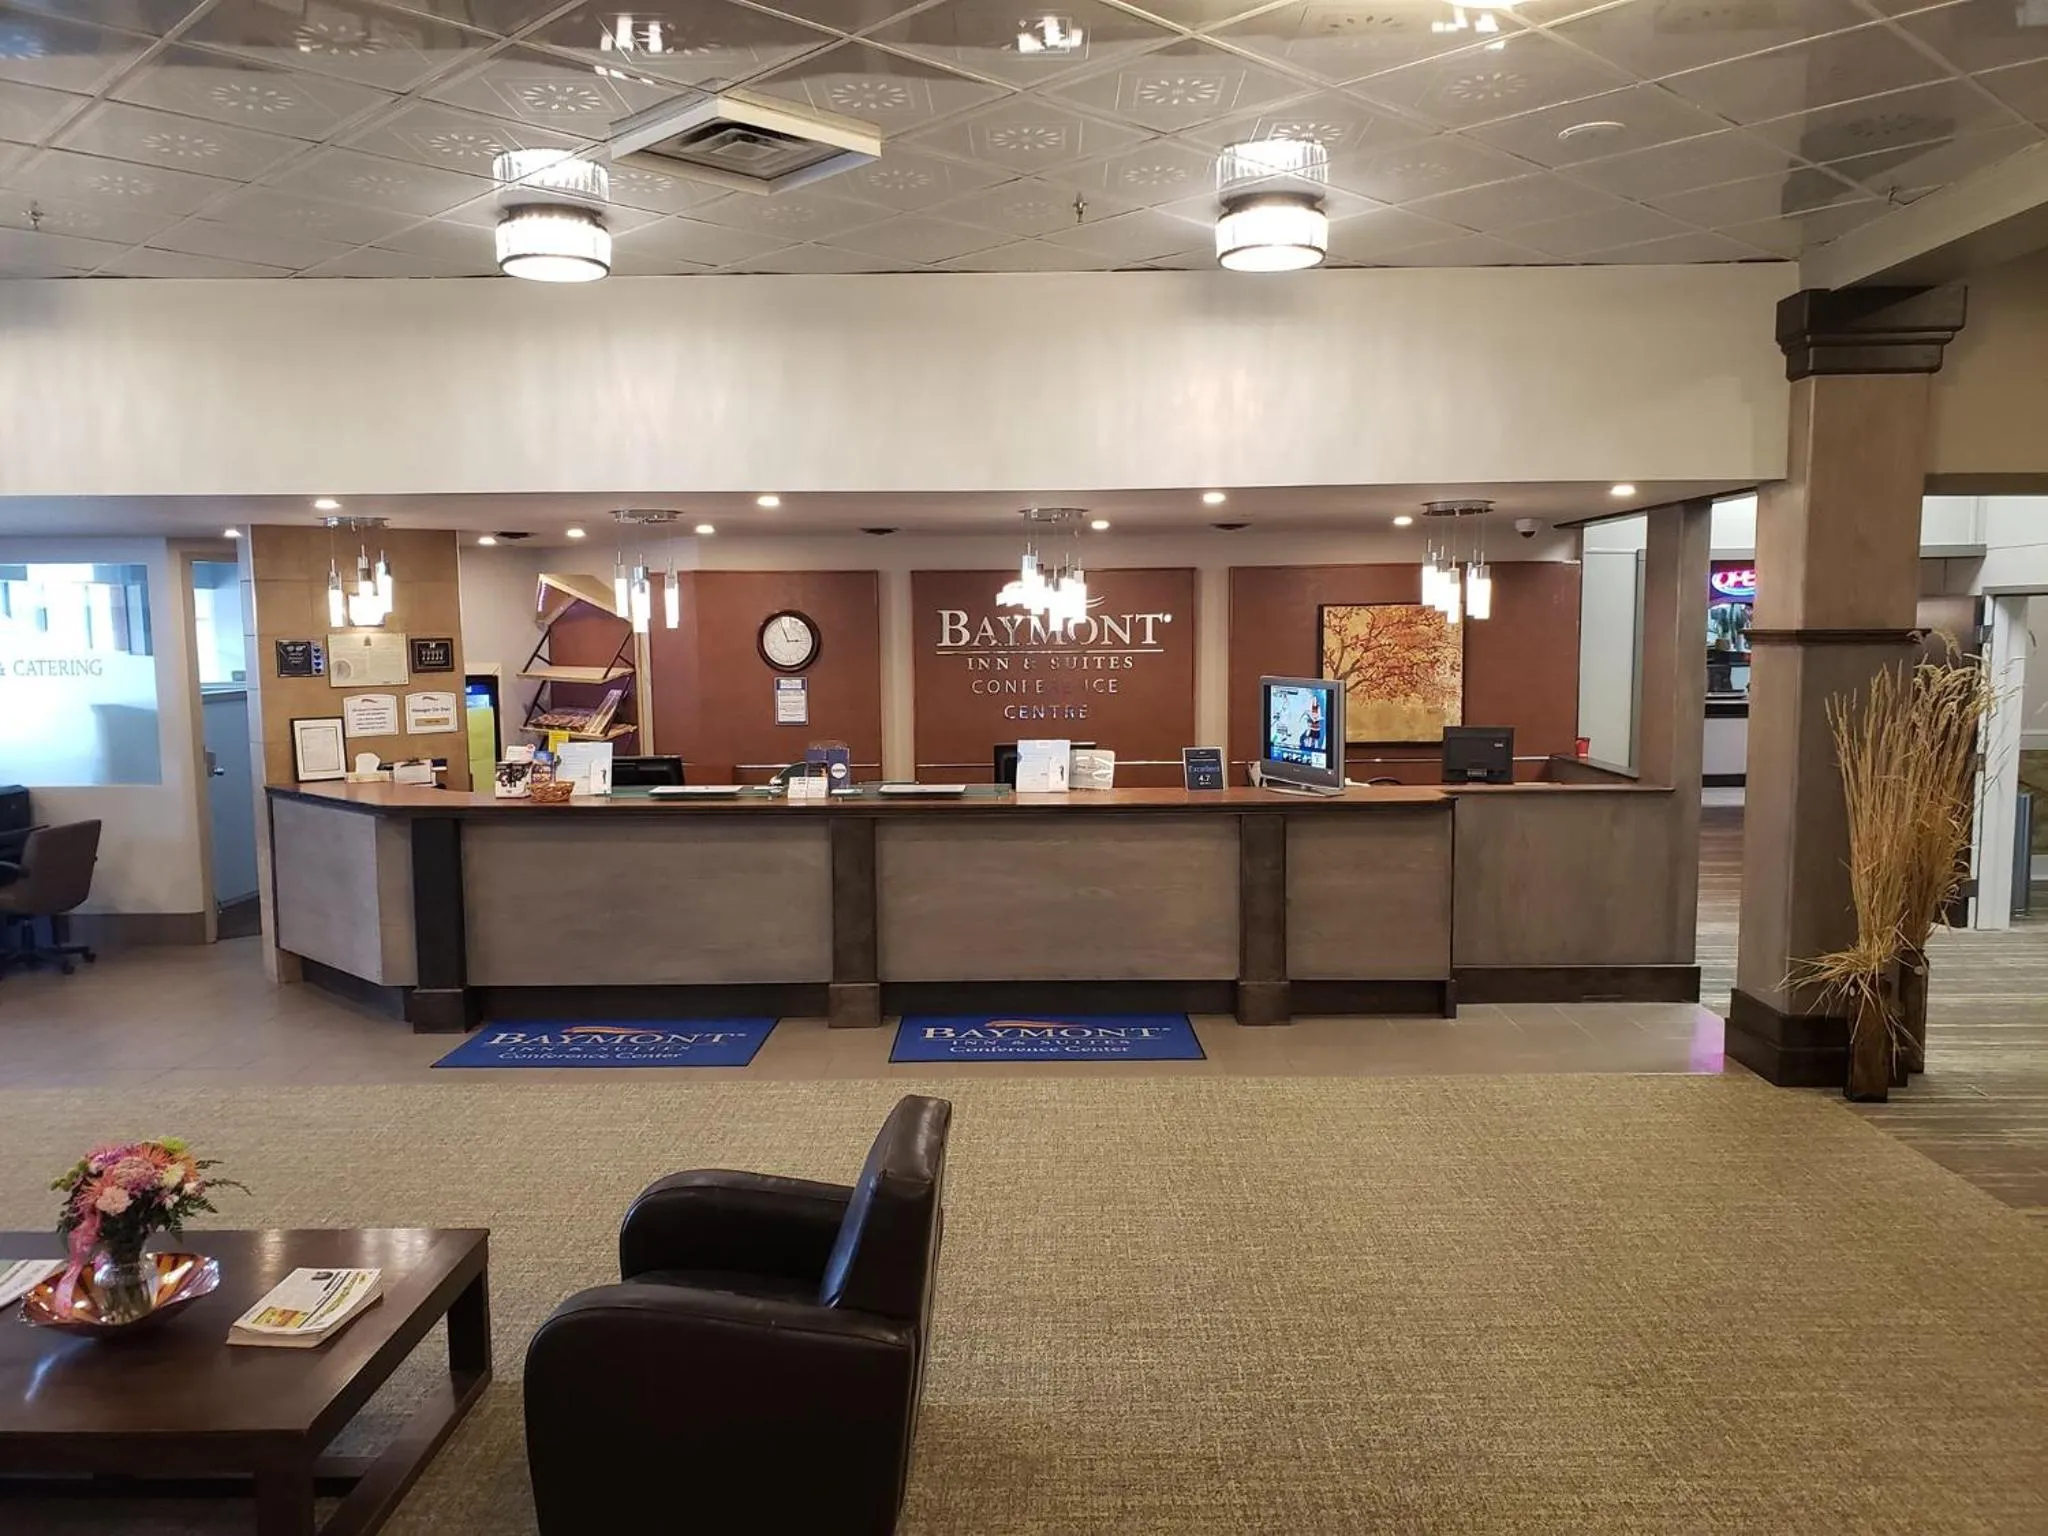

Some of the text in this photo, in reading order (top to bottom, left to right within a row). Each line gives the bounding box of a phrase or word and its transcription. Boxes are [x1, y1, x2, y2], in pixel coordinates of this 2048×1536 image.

[936, 609, 1164, 647] BAYMONT
[13, 659, 103, 677] CATERING
[967, 655, 1133, 670] INN & SUITES
[971, 678, 1118, 694] CONECE
[1004, 704, 1088, 720] CENTRE
[488, 1032, 733, 1045] BAYMONT
[922, 1027, 1160, 1038] BAYMONT
[498, 1051, 683, 1060] Conference Center
[949, 1045, 1130, 1053] Conference Center
